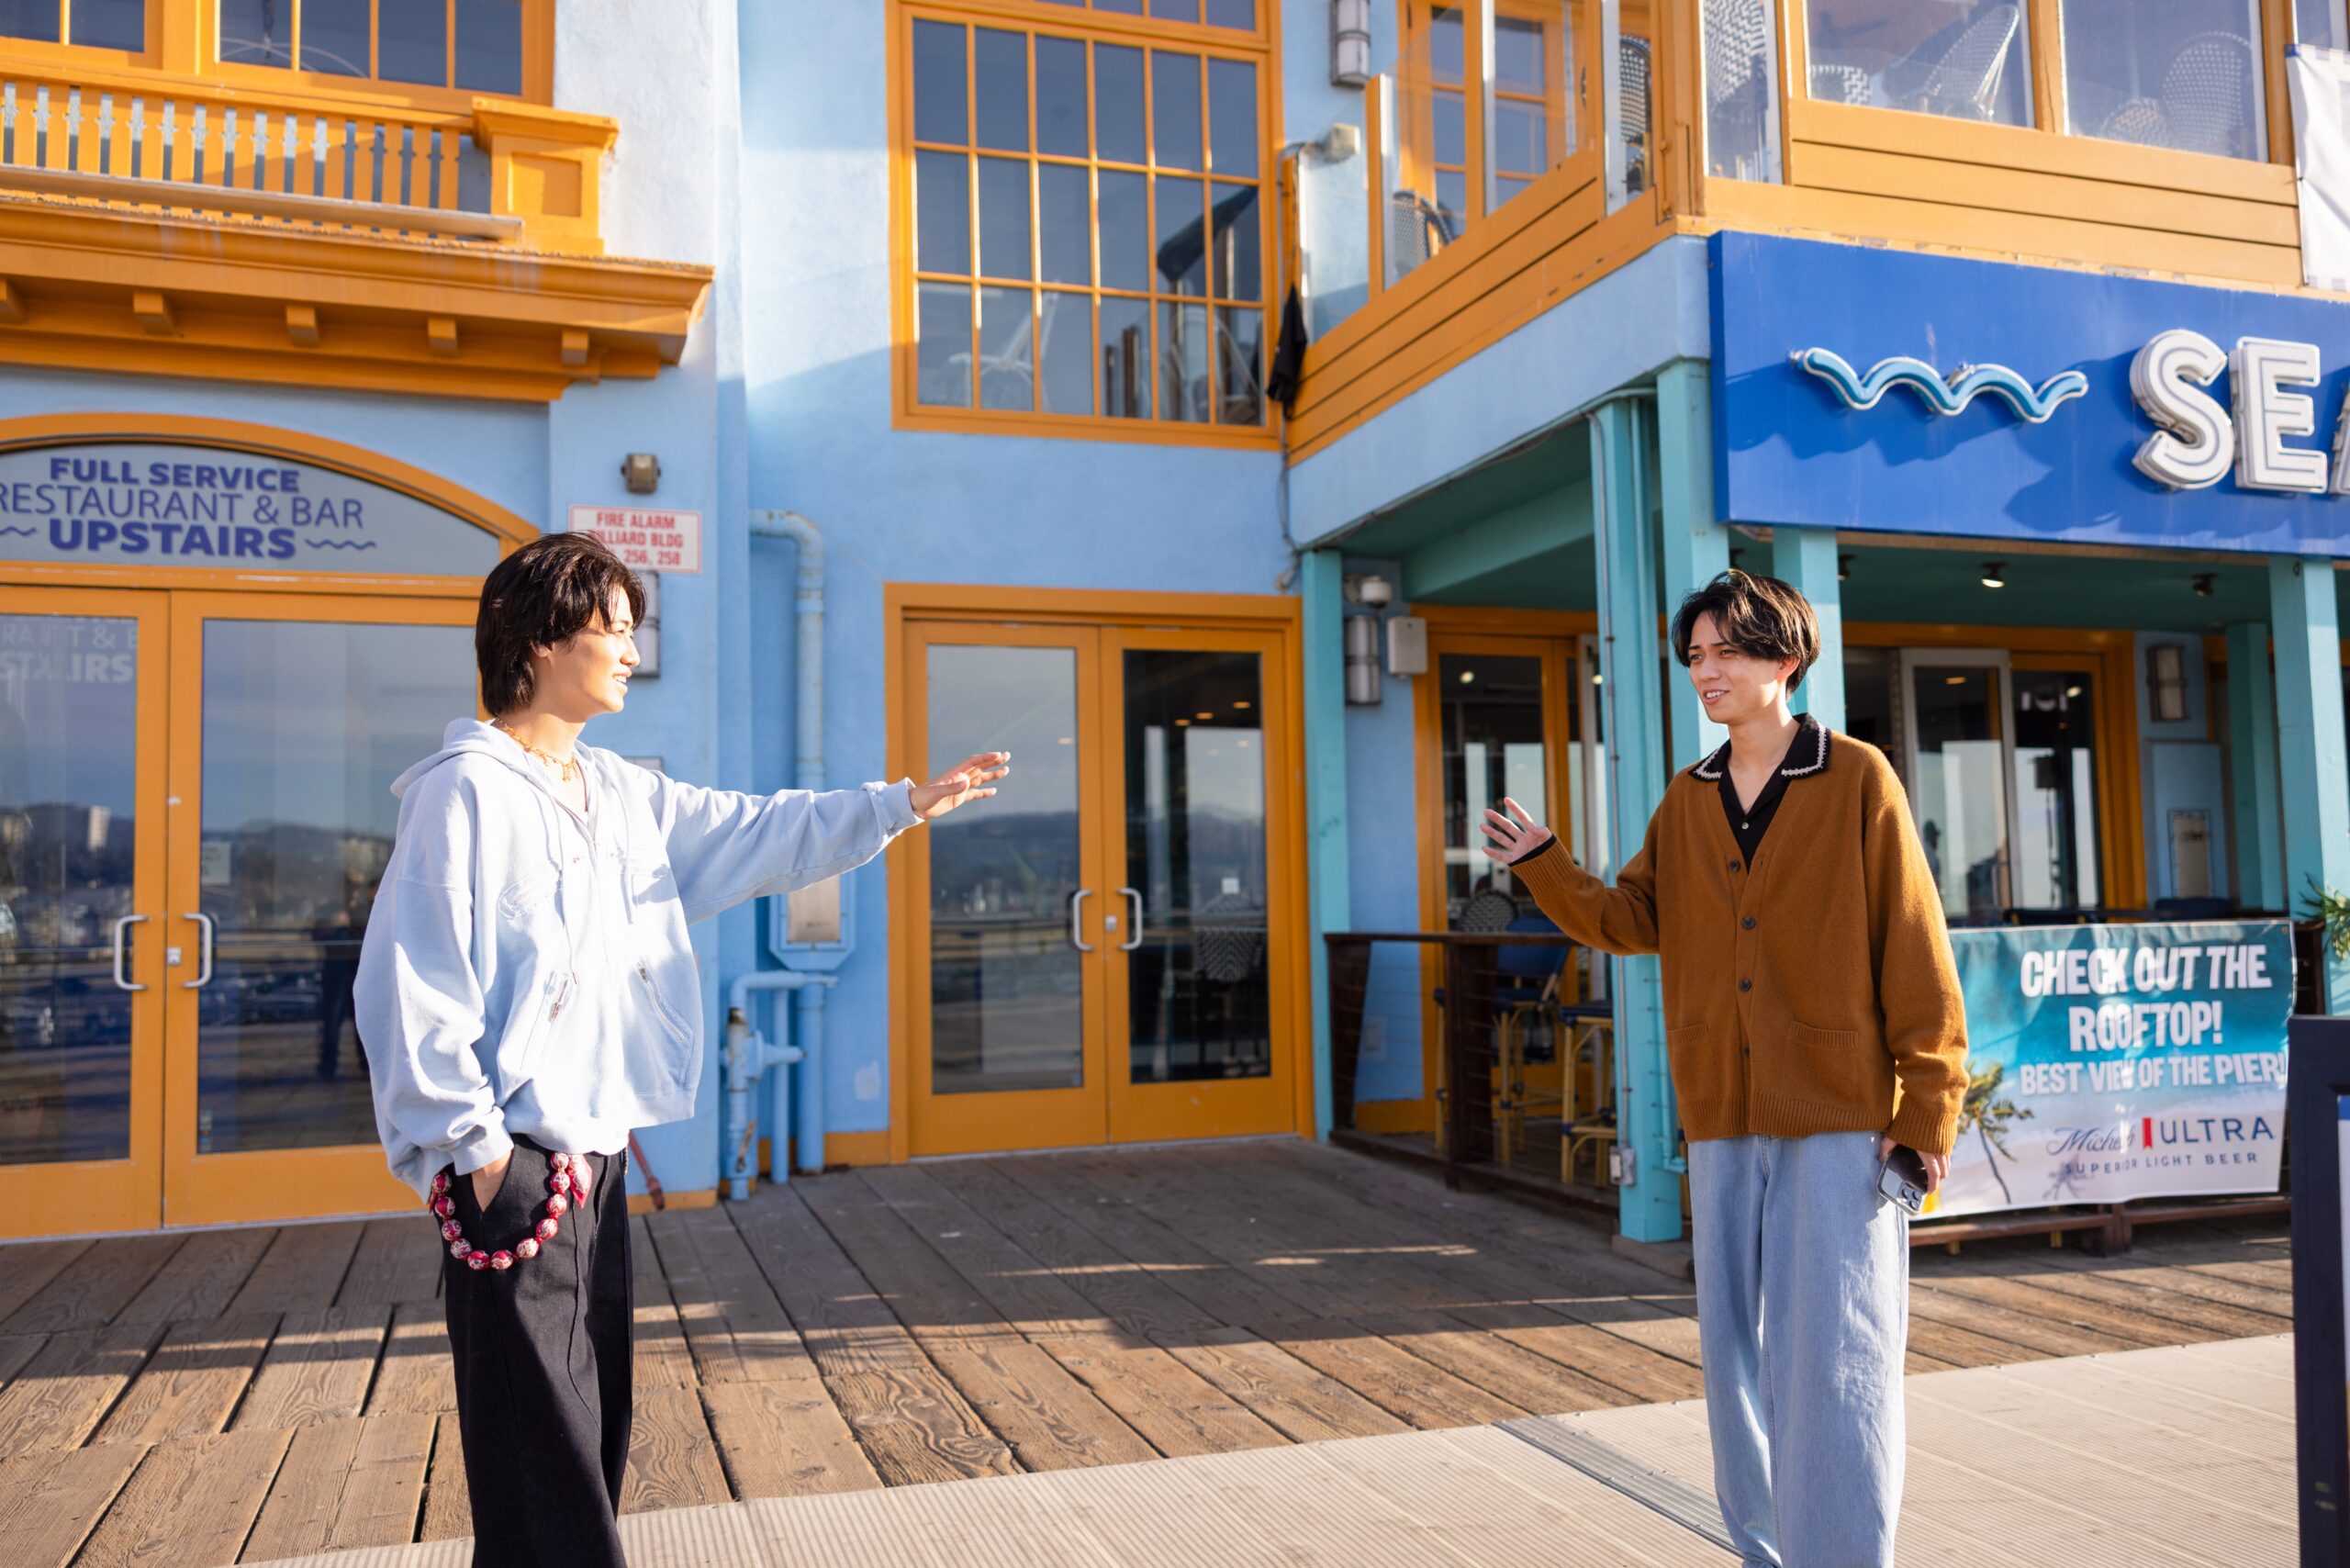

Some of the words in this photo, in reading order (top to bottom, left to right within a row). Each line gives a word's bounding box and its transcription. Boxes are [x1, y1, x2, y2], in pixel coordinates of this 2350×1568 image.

[2130, 329, 2350, 494] SE
[50, 457, 140, 485] FULL
[149, 462, 301, 493] SERVICE
[253, 494, 279, 526] &
[291, 496, 364, 529] BAR
[597, 512, 625, 528] FIRE
[631, 514, 675, 530] ALARM
[49, 518, 297, 560] UPSTAIRS
[651, 532, 684, 548] BLDG
[657, 551, 681, 566] 258
[2020, 947, 2131, 998] CHECK
[2133, 946, 2202, 993] OUT
[2206, 945, 2273, 990] THE
[2068, 1001, 2223, 1052] ROOFTOP!
[2020, 1062, 2083, 1096] BEST
[2088, 1058, 2135, 1092] VIEW
[2138, 1057, 2165, 1089] OF
[2168, 1056, 2212, 1087] THE
[2214, 1052, 2288, 1085] PIER!
[2160, 1116, 2275, 1144] ULTRA
[2065, 1158, 2138, 1175] SUPERIOR
[2145, 1154, 2193, 1169] LIGHT
[2205, 1152, 2258, 1166] BEER
